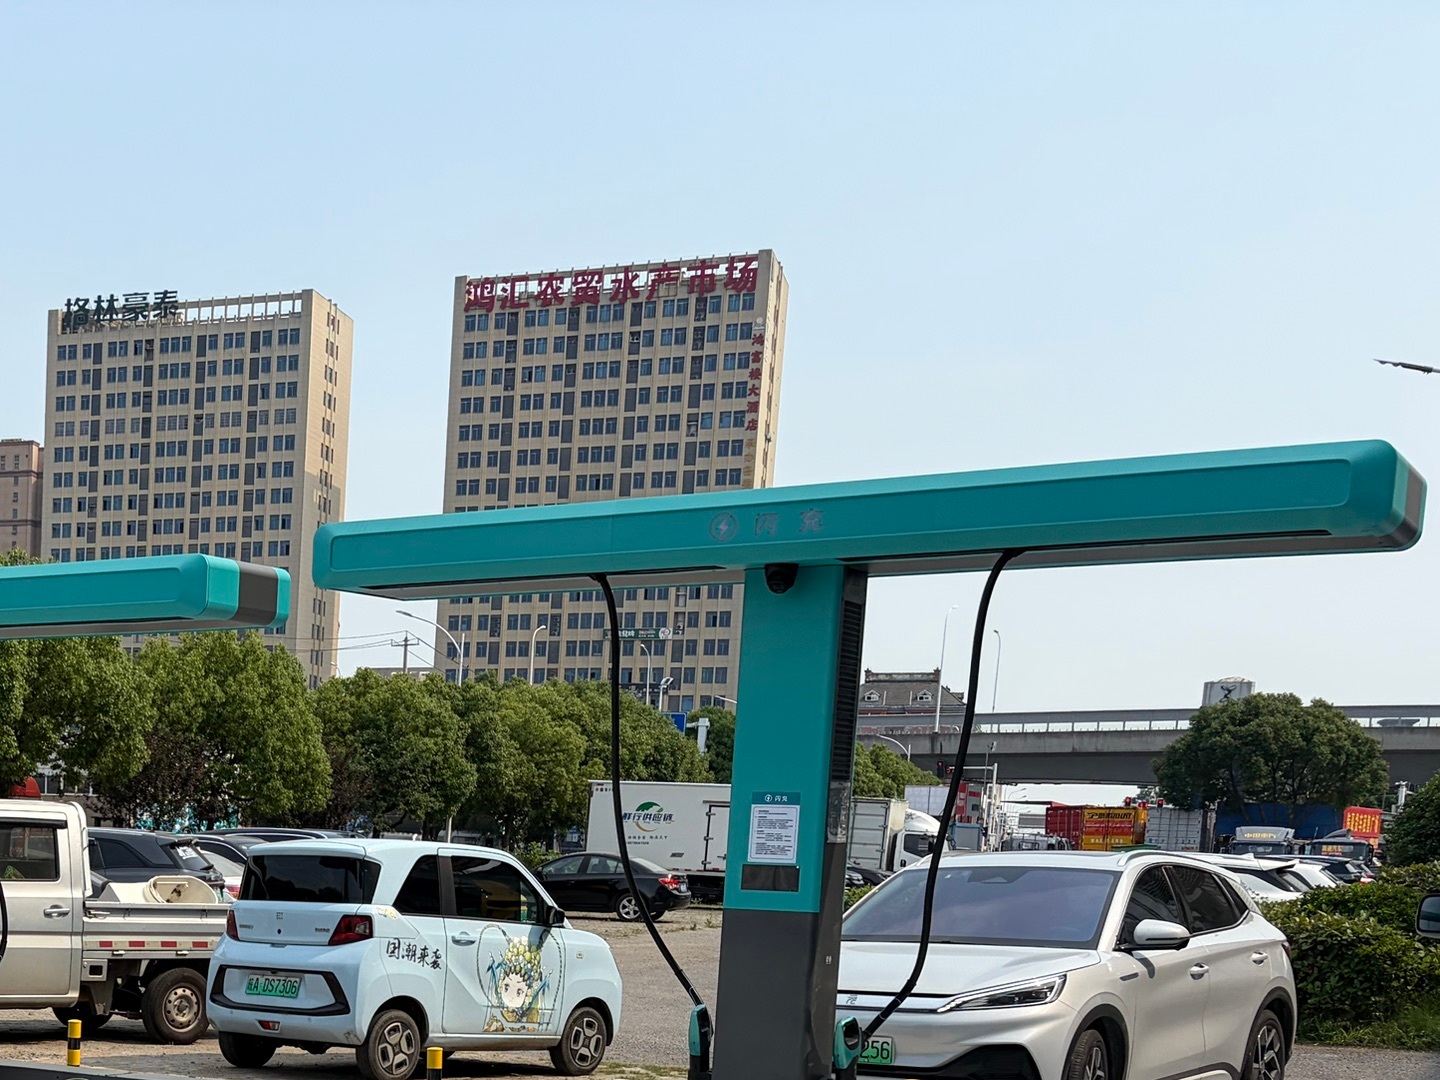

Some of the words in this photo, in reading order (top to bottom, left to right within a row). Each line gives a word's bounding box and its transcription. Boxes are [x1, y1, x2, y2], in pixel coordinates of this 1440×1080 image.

[464, 256, 758, 313] 鸿汇农贸水产市场
[63, 290, 178, 329] 格林豪泰
[755, 508, 824, 537] 闪充
